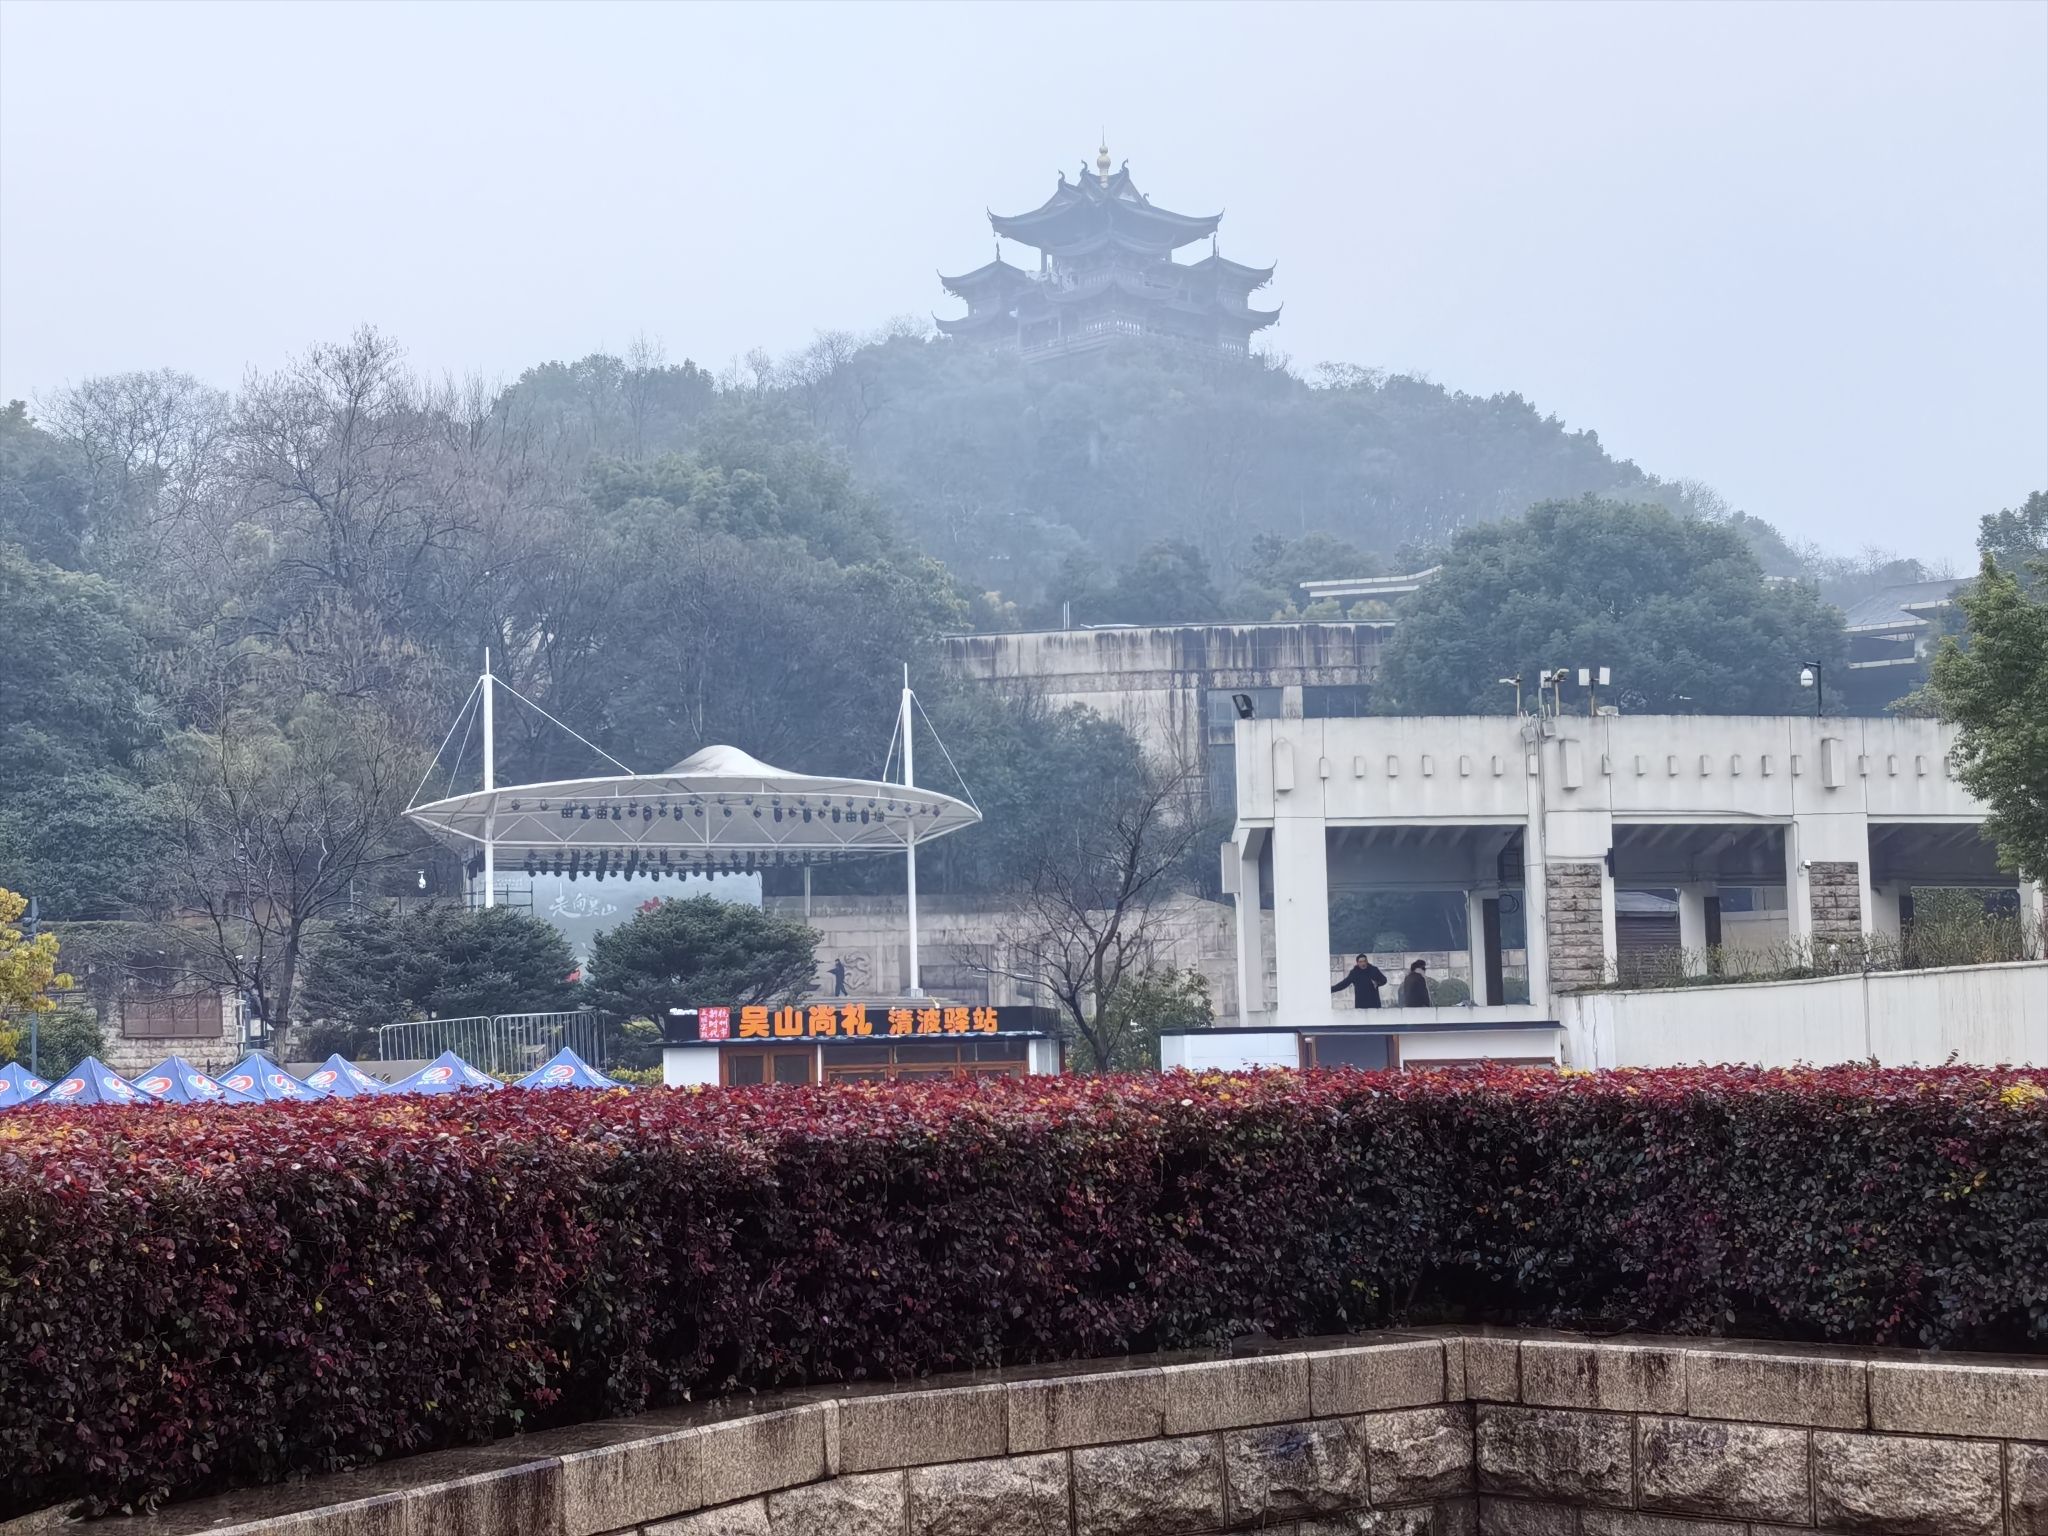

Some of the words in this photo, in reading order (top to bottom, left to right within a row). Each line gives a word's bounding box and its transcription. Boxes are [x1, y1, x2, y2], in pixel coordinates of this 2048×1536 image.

[739, 1003, 873, 1037] 吴山尚礼
[888, 1006, 998, 1035] 清波驿站
